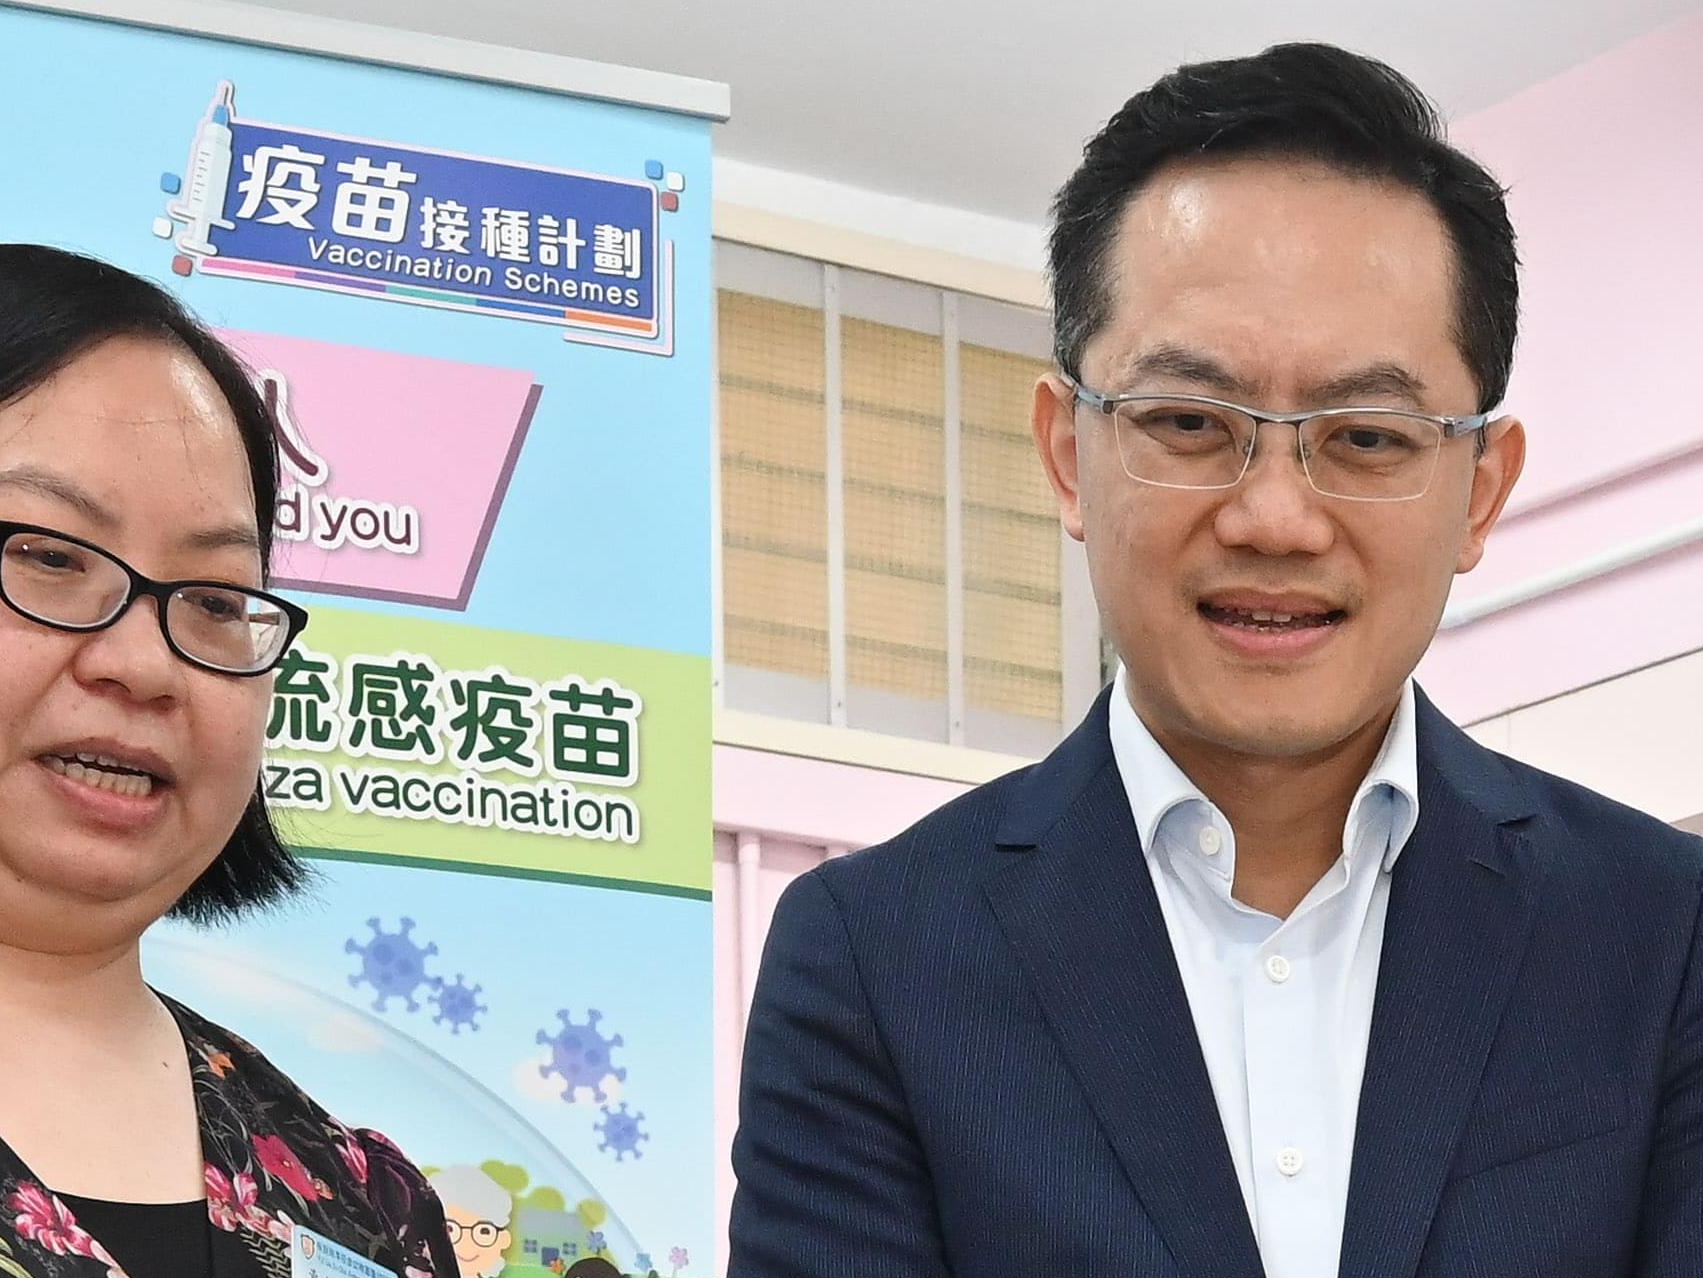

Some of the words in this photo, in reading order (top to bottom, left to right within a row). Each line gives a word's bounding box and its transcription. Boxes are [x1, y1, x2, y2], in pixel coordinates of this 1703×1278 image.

[236, 144, 643, 279] 疫苗接種計劃
[308, 237, 492, 286] Vaccination
[505, 269, 639, 308] Schemes
[319, 500, 412, 546] you
[267, 649, 634, 778] 流感疫苗
[340, 772, 633, 836] vaccination
